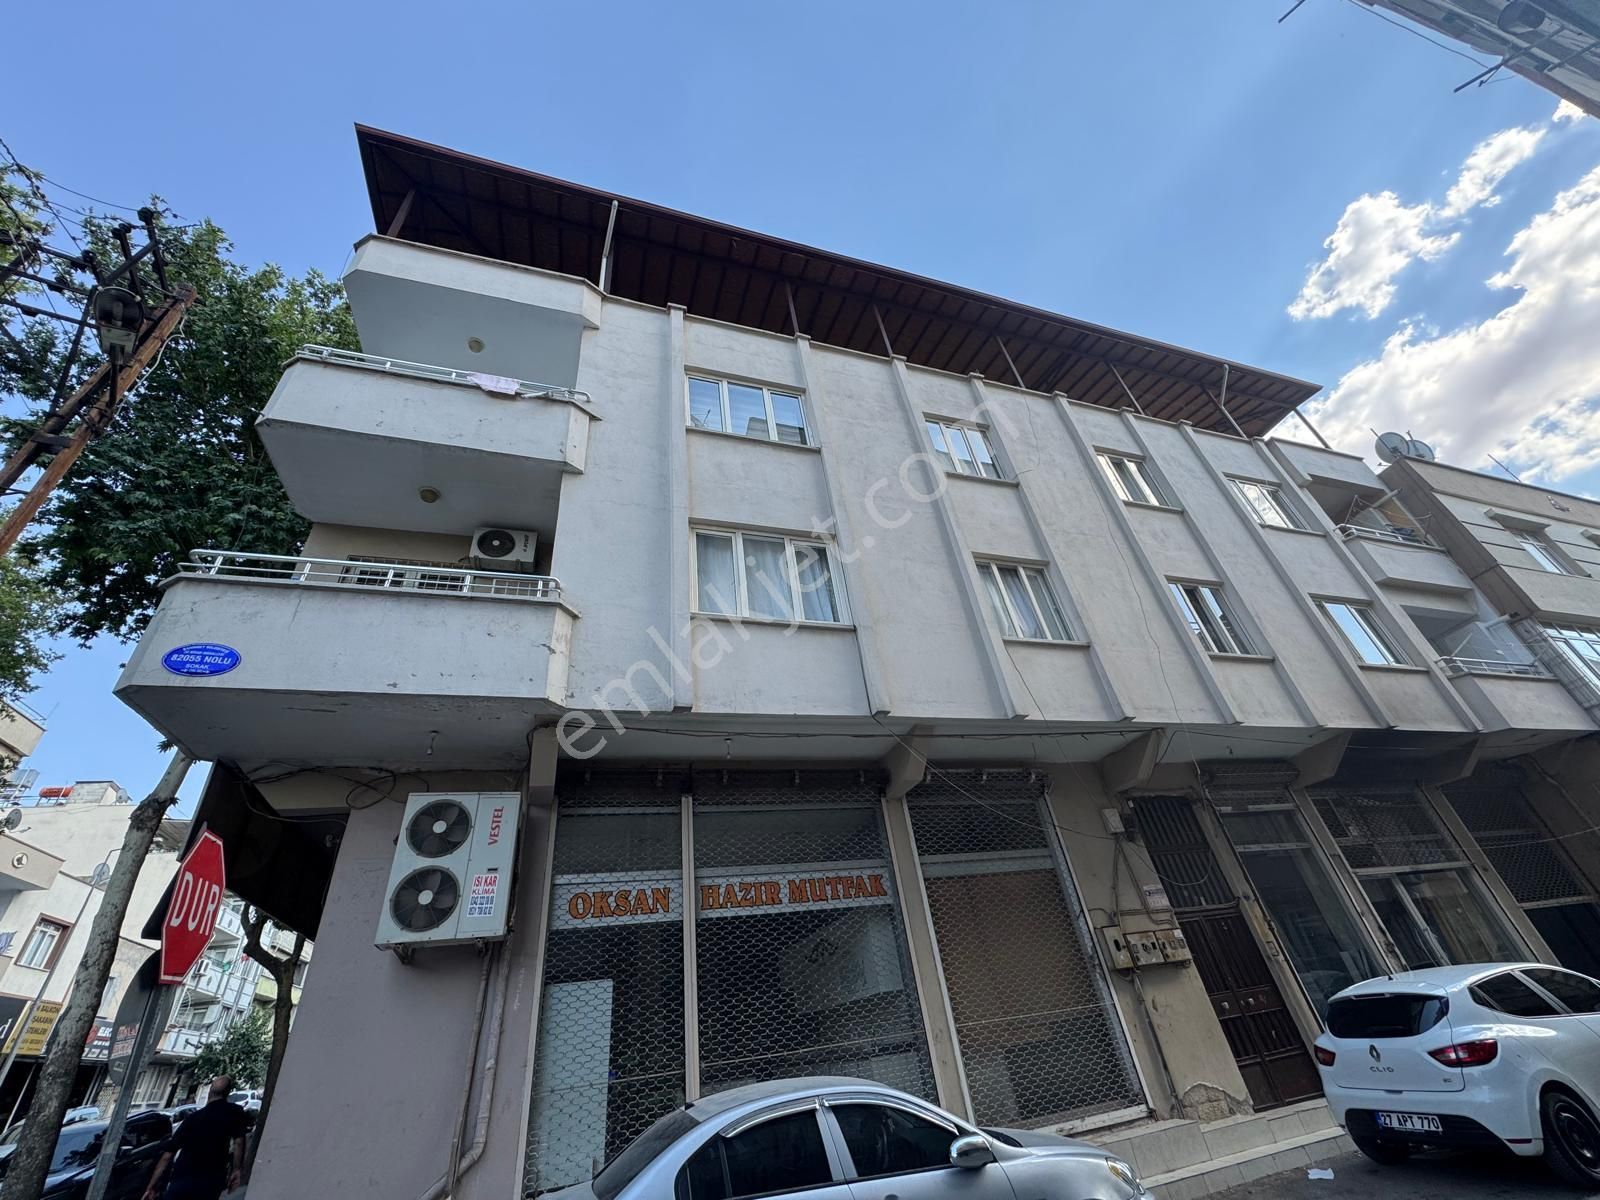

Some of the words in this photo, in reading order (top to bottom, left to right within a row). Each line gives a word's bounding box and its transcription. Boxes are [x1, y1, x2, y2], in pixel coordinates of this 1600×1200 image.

[203, 656, 231, 665] NOLU
[488, 806, 504, 846] VESTEL
[483, 875, 498, 888] KAR
[170, 871, 220, 936] DUR
[568, 887, 671, 920] OKSAN
[700, 880, 782, 910] HAZIR
[787, 874, 888, 903] MUTFAK
[1380, 1113, 1393, 1127] 27
[1417, 1115, 1440, 1130] 770
